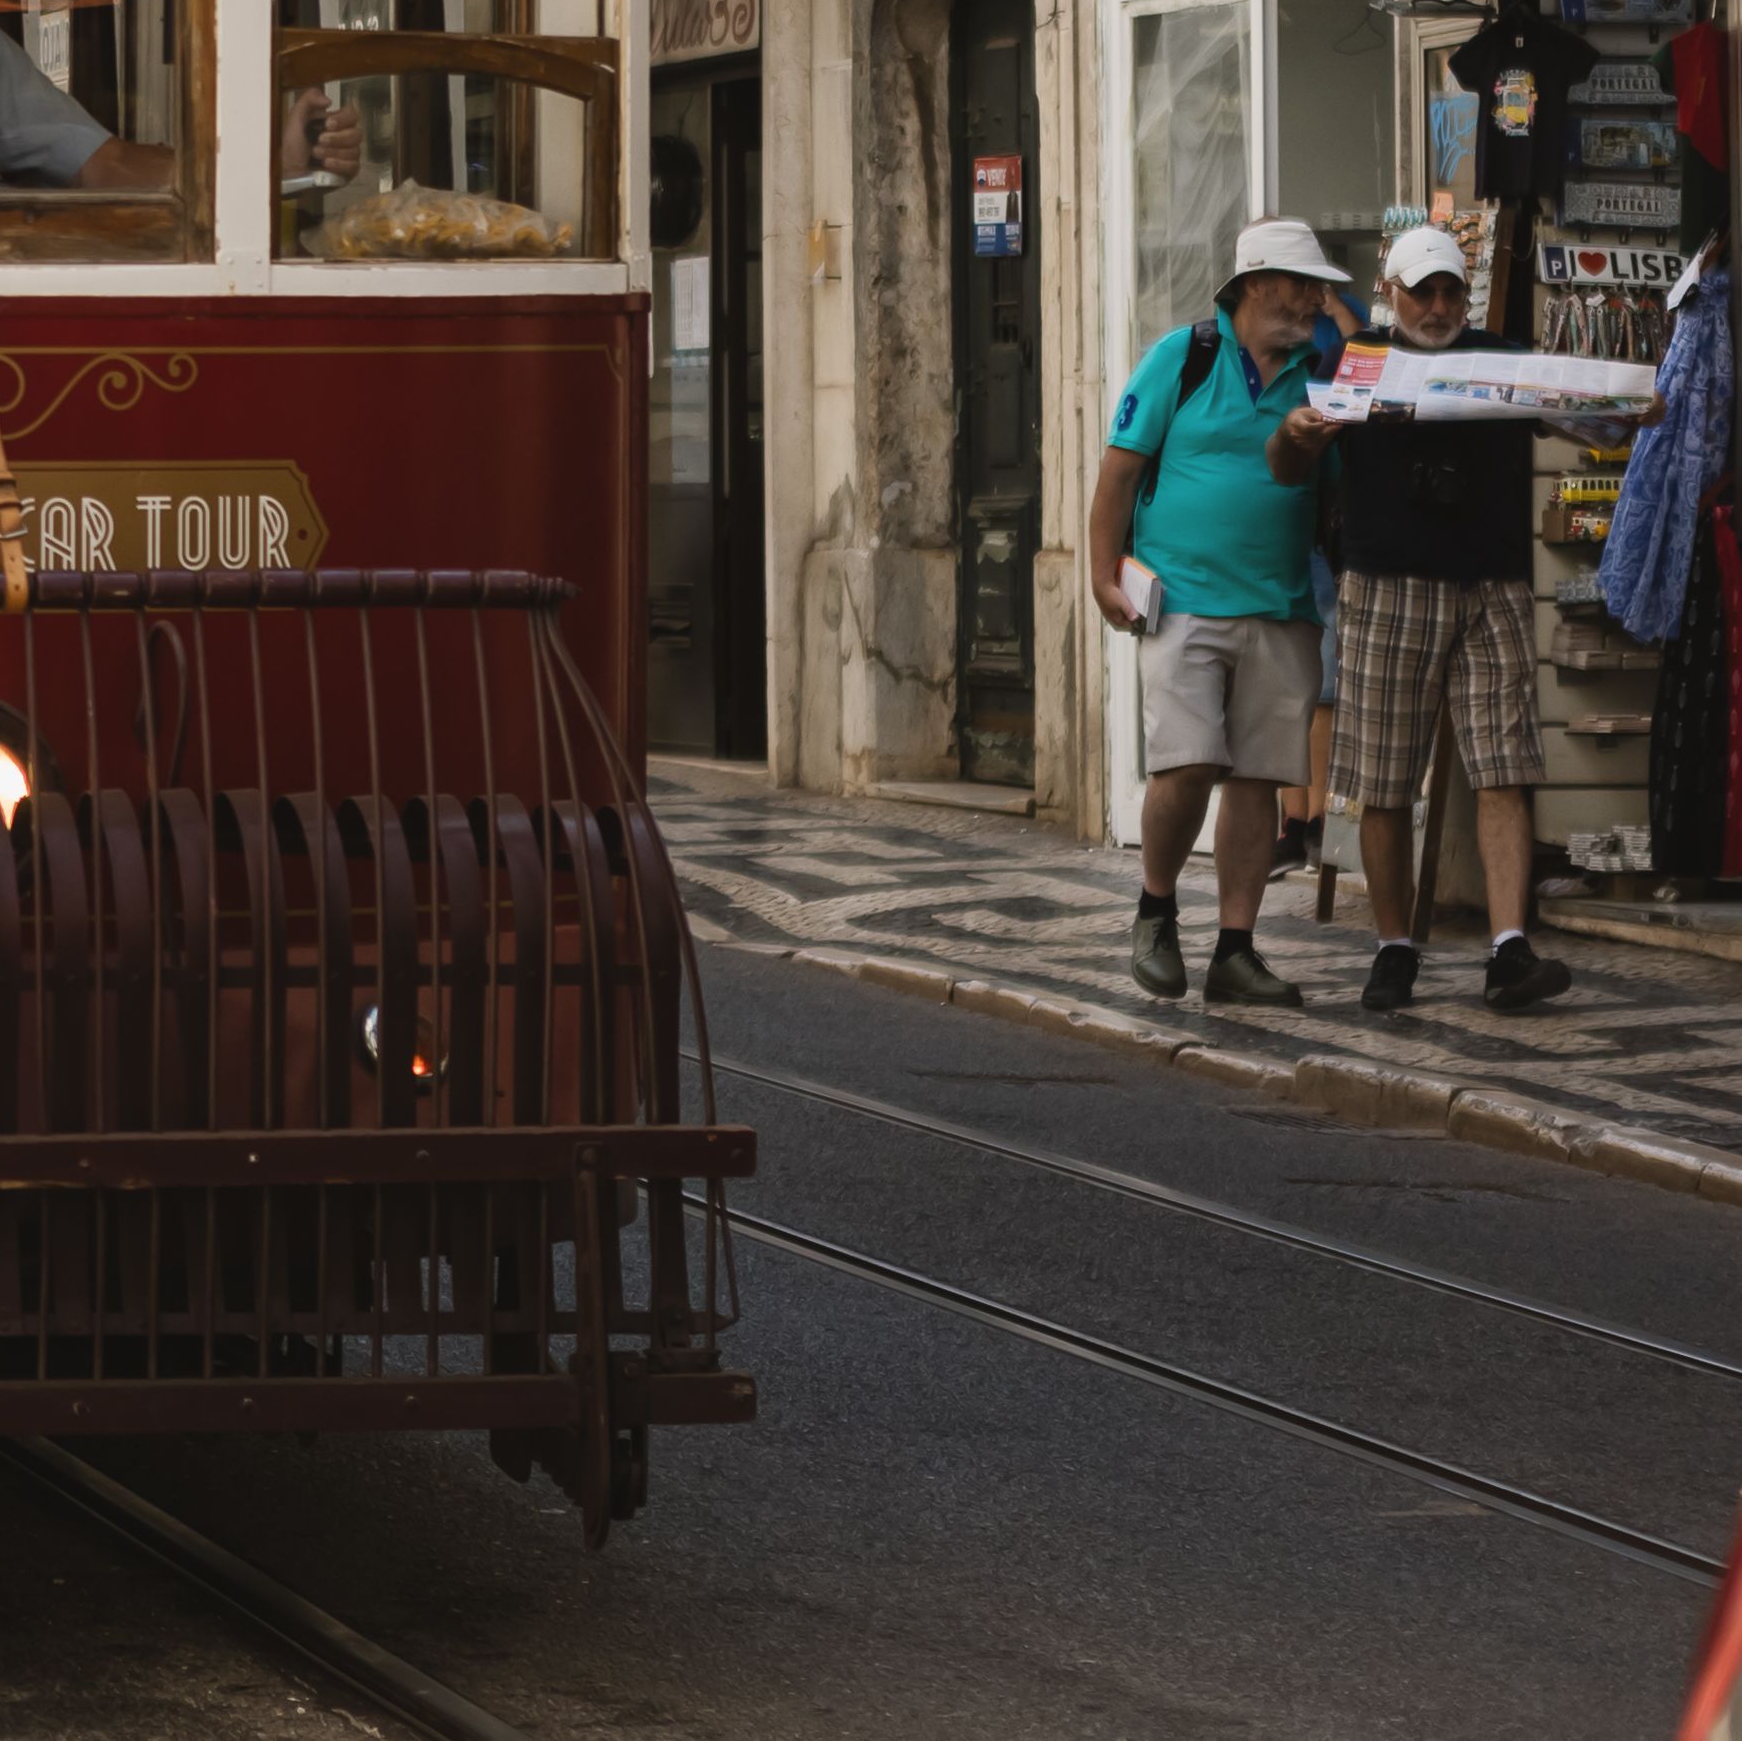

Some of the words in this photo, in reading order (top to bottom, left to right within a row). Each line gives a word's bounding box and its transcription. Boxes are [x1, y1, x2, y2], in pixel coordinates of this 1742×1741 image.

[1596, 198, 1660, 213] PORTUGAL
[1551, 260, 1563, 276] P
[1117, 393, 1139, 432] 3
[136, 495, 292, 572] TOUR
